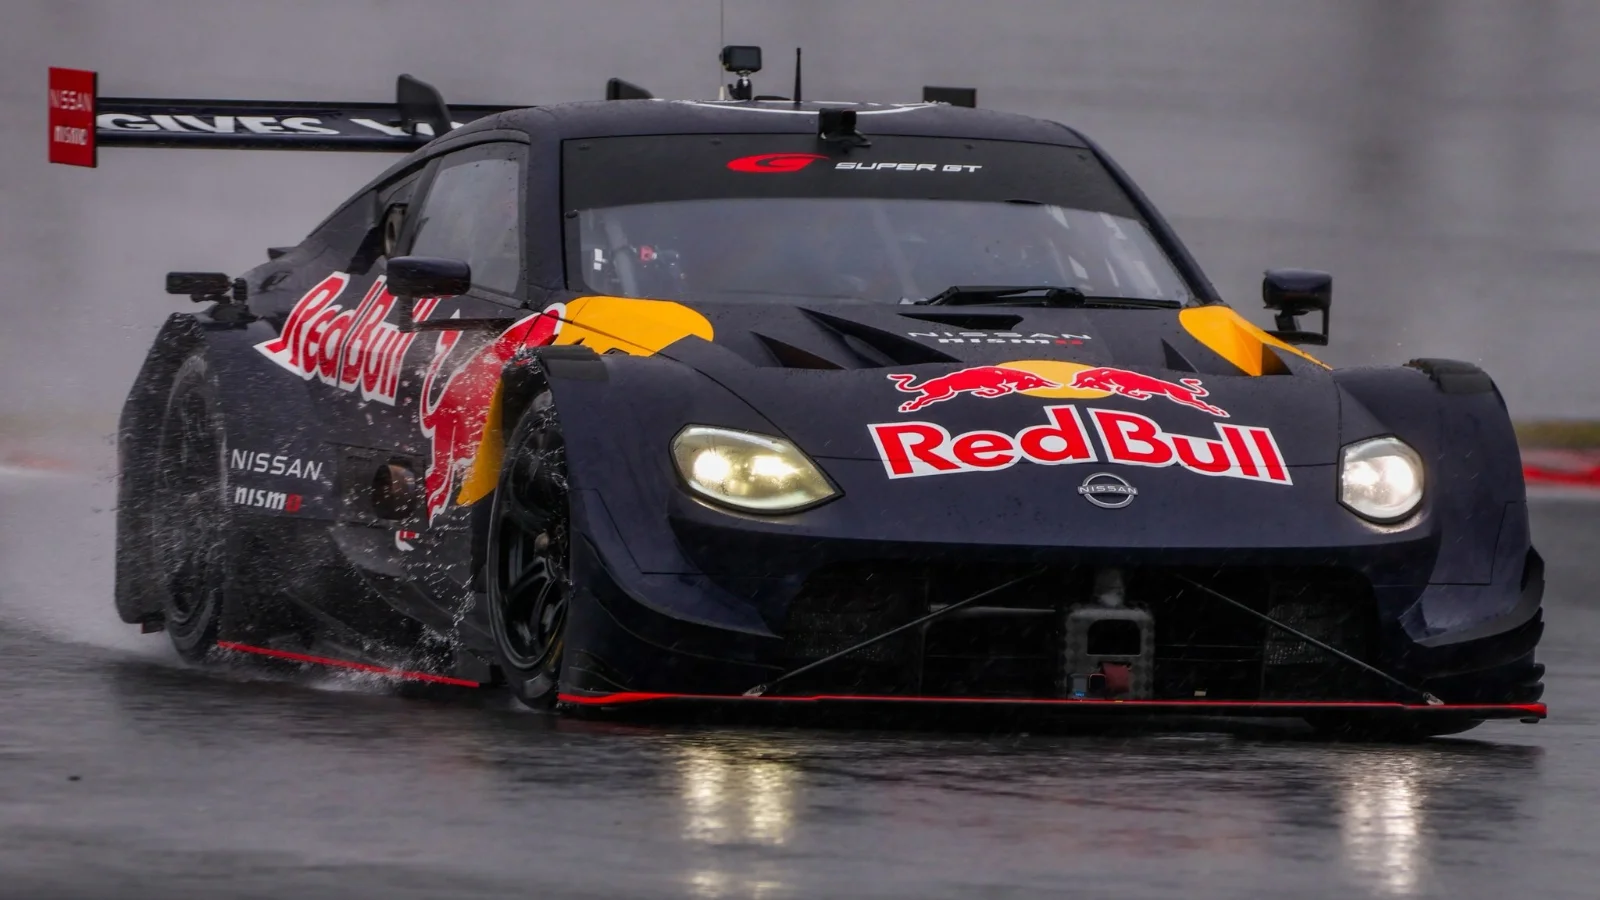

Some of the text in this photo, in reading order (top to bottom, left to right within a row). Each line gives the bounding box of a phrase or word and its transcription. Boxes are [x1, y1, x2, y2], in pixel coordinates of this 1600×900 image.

[50, 89, 92, 112] NISSAN
[97, 113, 340, 135] GIVES
[835, 161, 983, 173] SUPER GT
[255, 271, 441, 405] Red Bull
[907, 331, 1092, 340] NISSAN
[870, 406, 1292, 485] Red Bull
[231, 448, 323, 480] NISSAN
[1079, 485, 1137, 494] NISSAN
